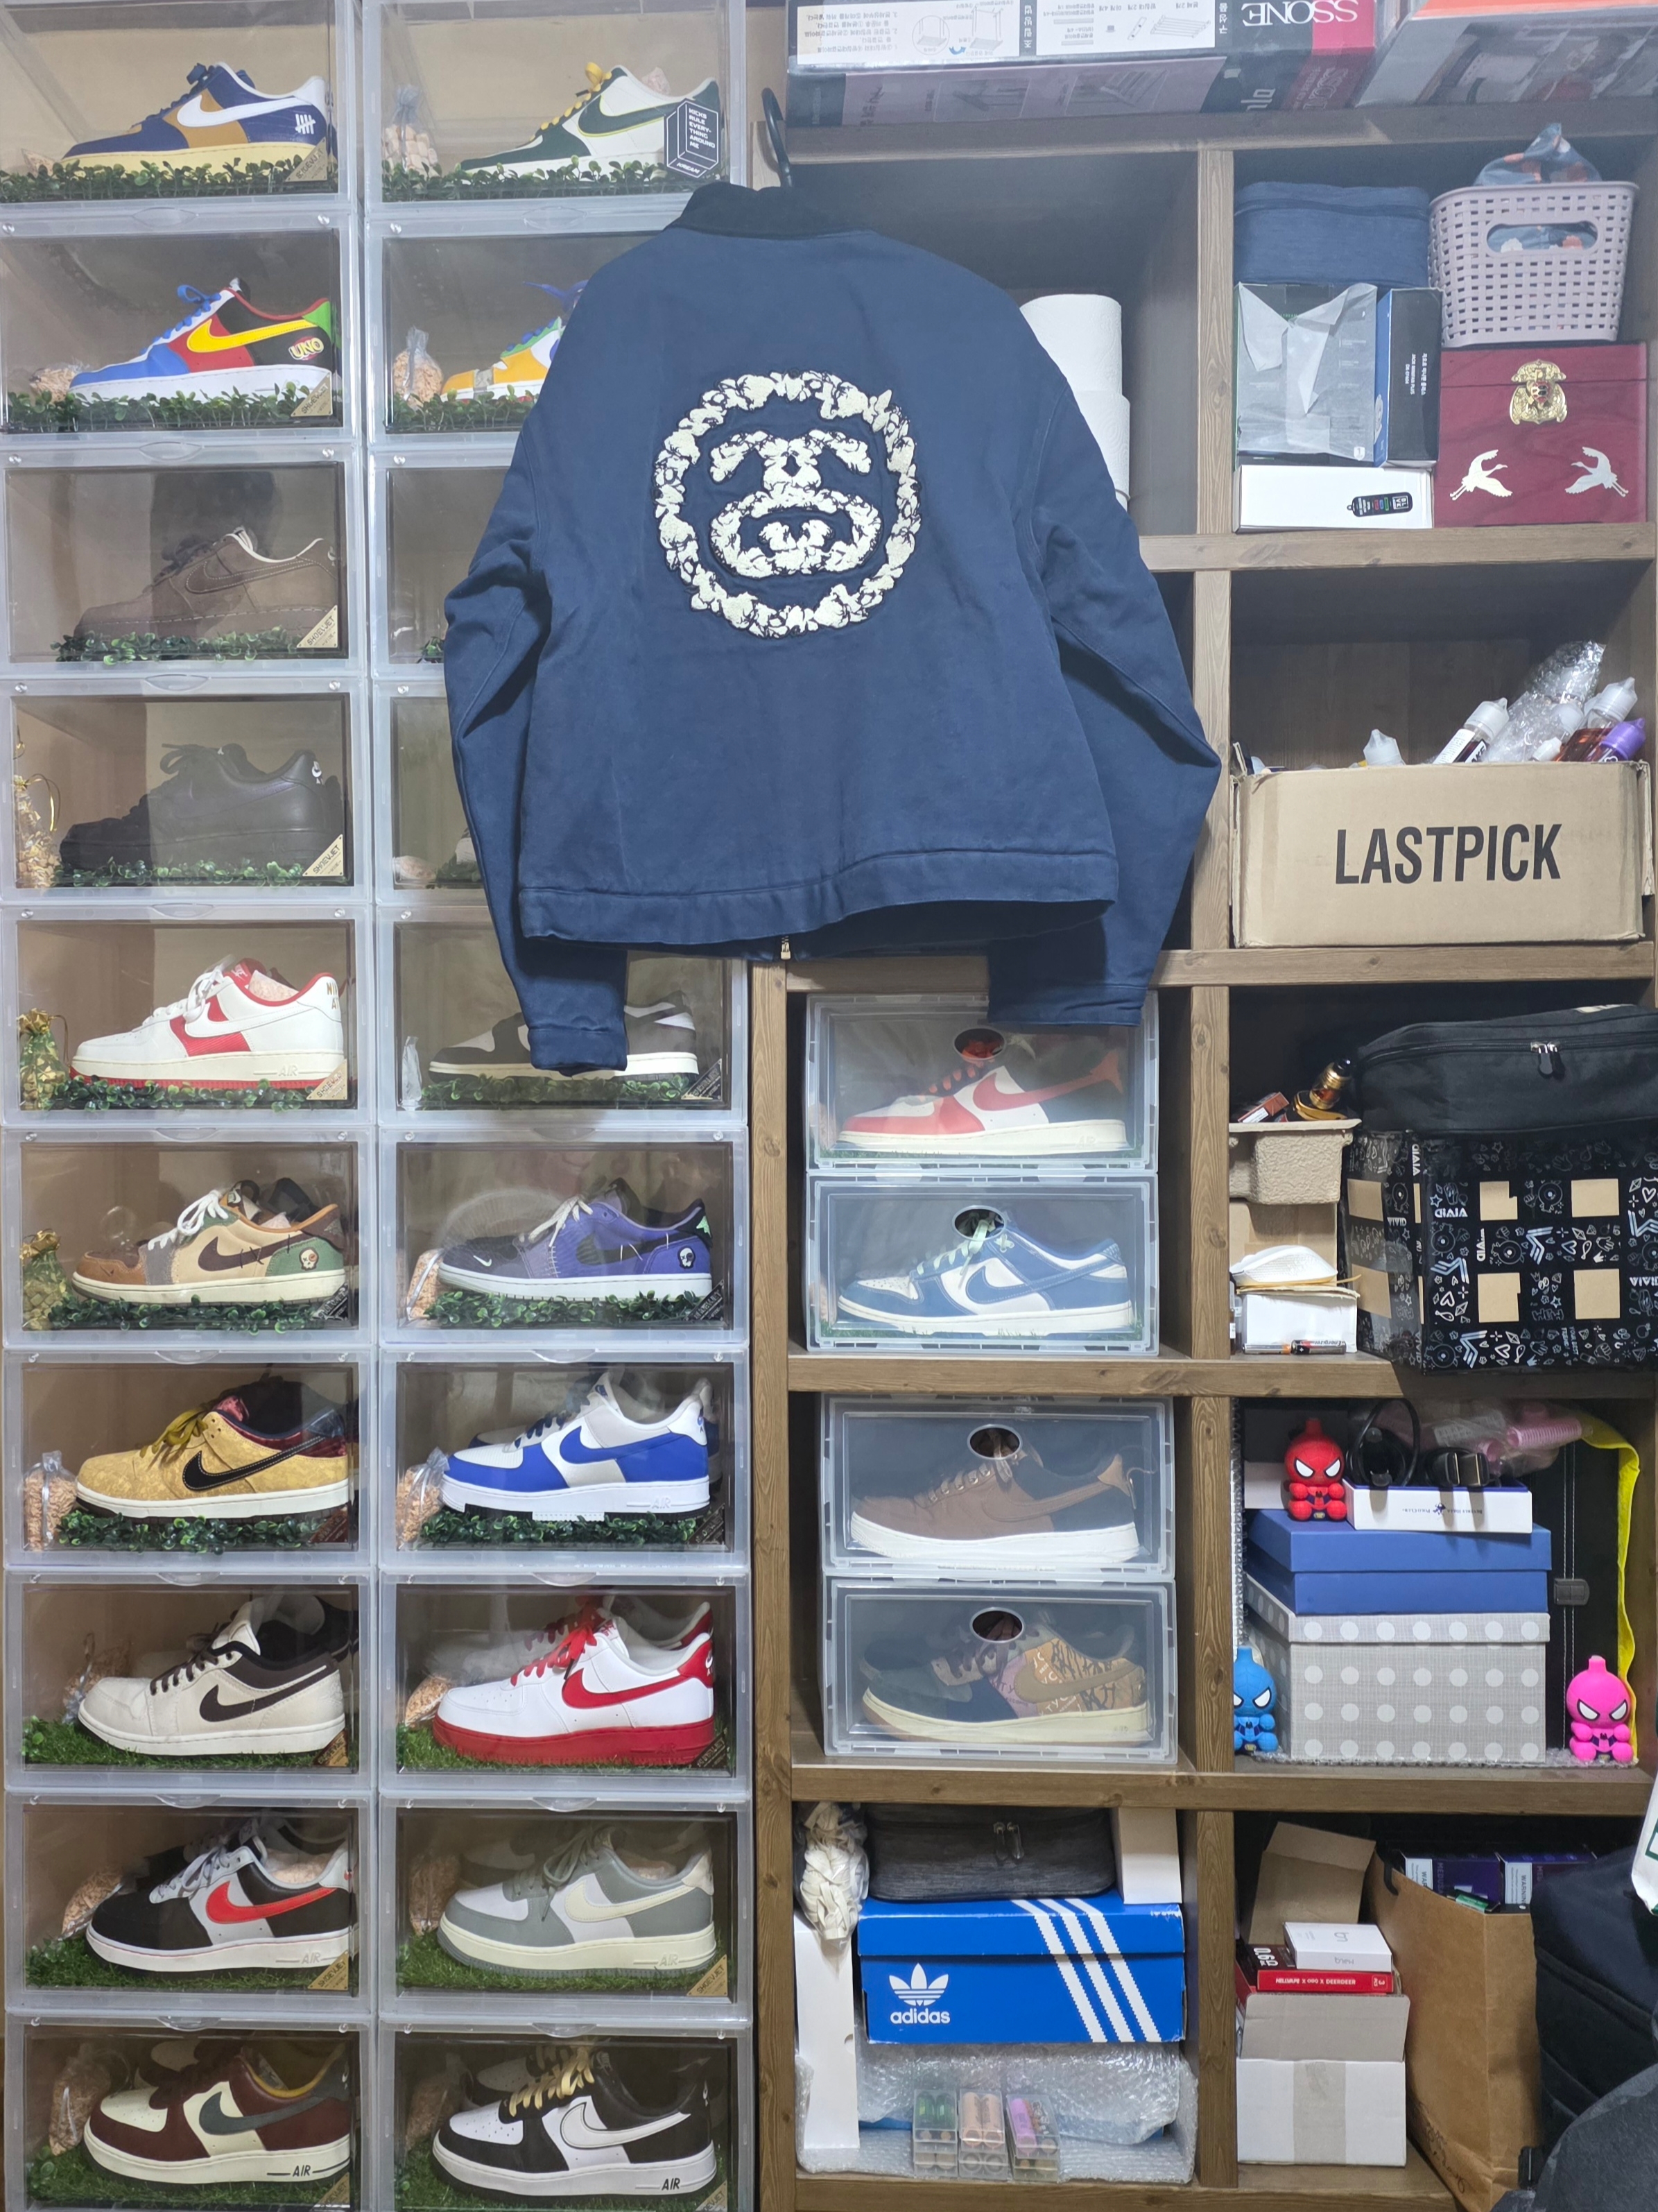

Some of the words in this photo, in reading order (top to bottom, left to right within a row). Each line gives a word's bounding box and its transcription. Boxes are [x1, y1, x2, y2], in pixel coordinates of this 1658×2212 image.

[689, 108, 707, 119] KICKS
[689, 114, 705, 125] RULE
[689, 121, 711, 132] EVERY-
[689, 128, 708, 139] THING
[689, 135, 716, 148] AROUND
[689, 141, 700, 149] ME
[677, 162, 700, 174] KREAM
[288, 337, 325, 360] UNO
[306, 615, 335, 646] SHOEVJET
[313, 844, 340, 874] SHOEVJET
[1336, 823, 1562, 885] LASTPICK
[279, 1065, 297, 1077] AIR
[1412, 1143, 1421, 1176] VIVID
[1435, 1207, 1468, 1218] VIVID
[1387, 1217, 1407, 1226] VIVID
[652, 1497, 671, 1509] AIR
[302, 1953, 321, 1964] AIR
[659, 1953, 679, 1966] AIR
[696, 1964, 725, 1994] SHOEVJET
[890, 2007, 951, 2024] adidas
[292, 2164, 311, 2177] AIR
[662, 2177, 681, 2190] AIR
